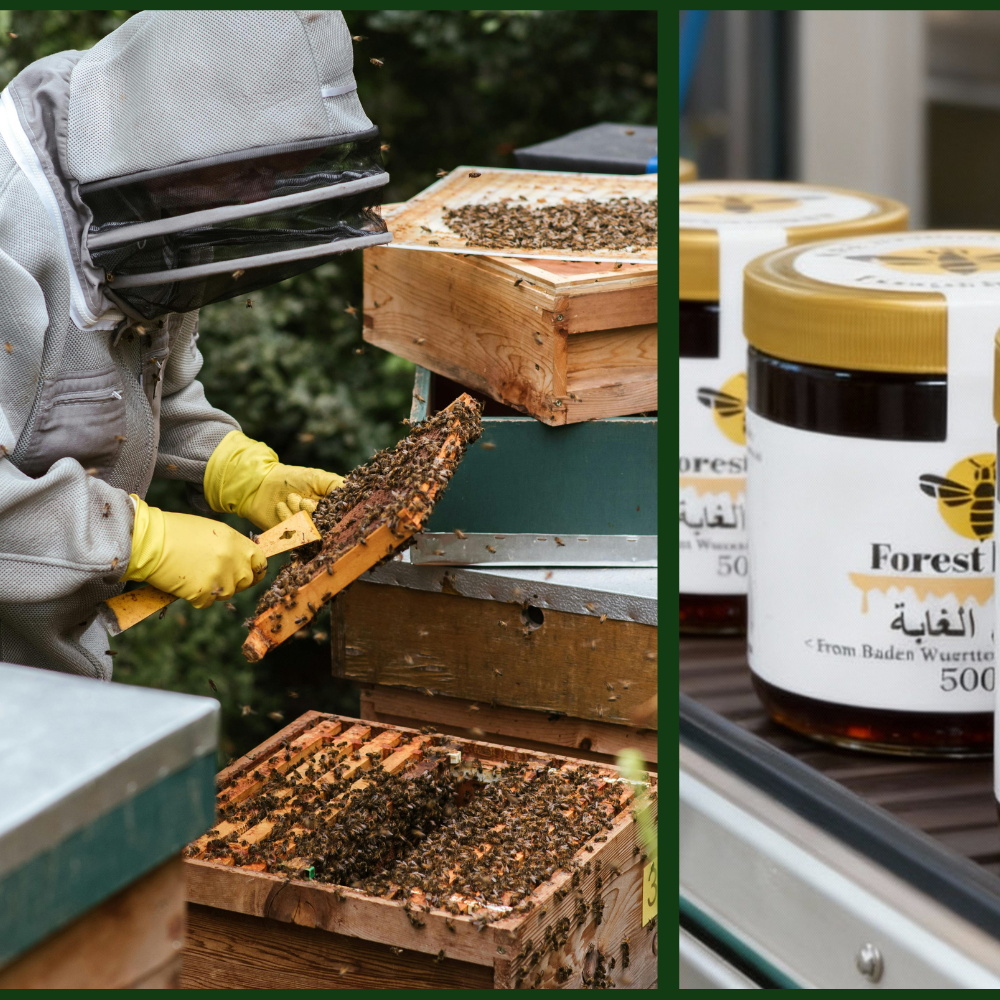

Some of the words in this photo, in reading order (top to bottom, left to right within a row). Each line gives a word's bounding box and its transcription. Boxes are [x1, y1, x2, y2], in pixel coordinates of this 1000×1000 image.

[870, 542, 986, 574] Forest
[890, 602, 975, 644] الغابة
[817, 638, 856, 657] From
[861, 644, 915, 661] Baden
